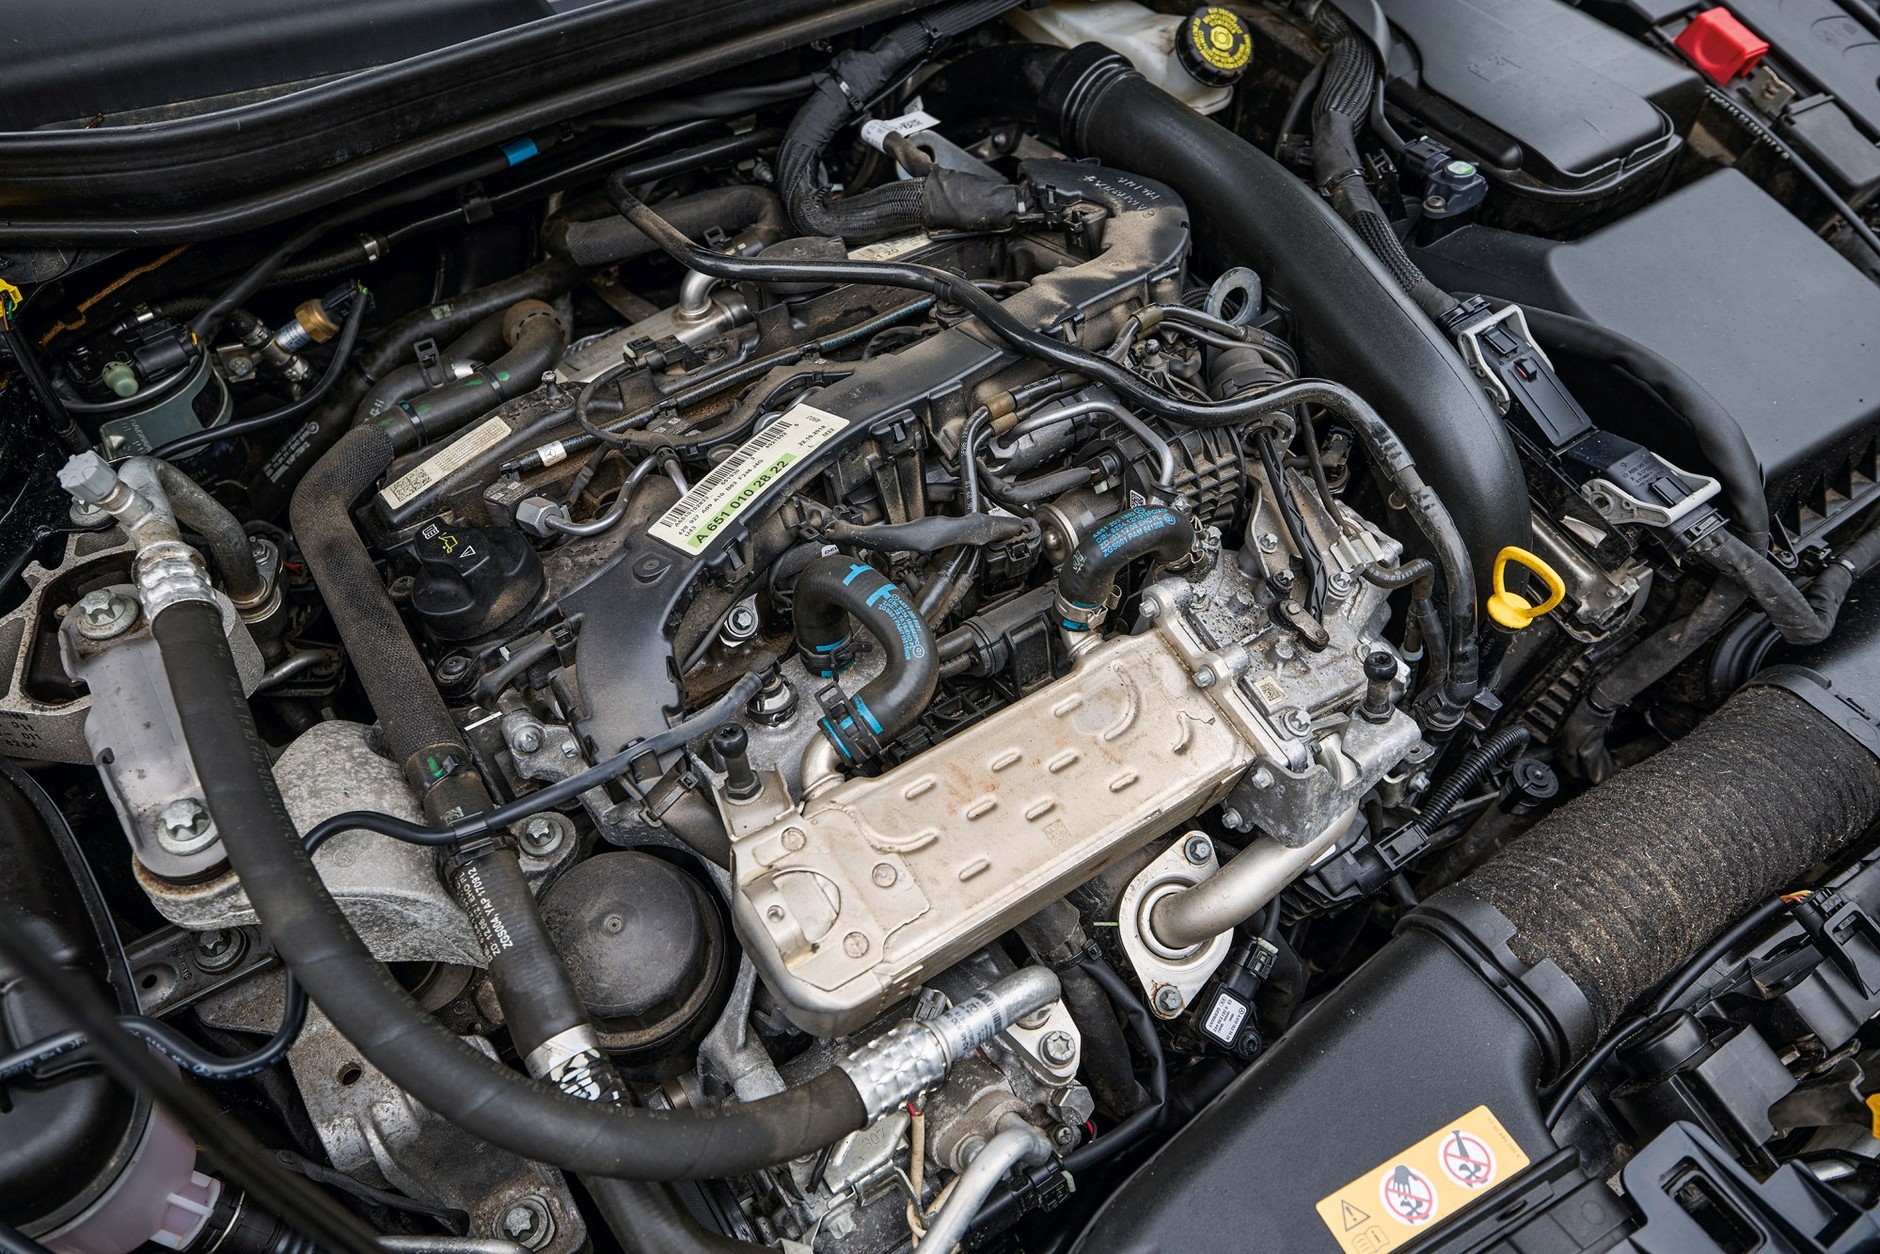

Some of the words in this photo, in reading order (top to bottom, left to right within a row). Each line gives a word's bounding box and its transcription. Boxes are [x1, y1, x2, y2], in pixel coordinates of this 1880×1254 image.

[696, 534, 708, 544] A
[706, 512, 730, 531] 651
[730, 490, 754, 508] 010
[754, 474, 771, 488] 28
[770, 460, 788, 474] 22
[1096, 533, 1111, 544] DBL
[1102, 538, 1128, 558] ZGS001
[1128, 529, 1144, 540] PAM
[464, 884, 476, 903] EHO
[468, 867, 486, 896] 170912
[480, 898, 495, 916] YAP
[490, 914, 514, 949] ZGS004,
